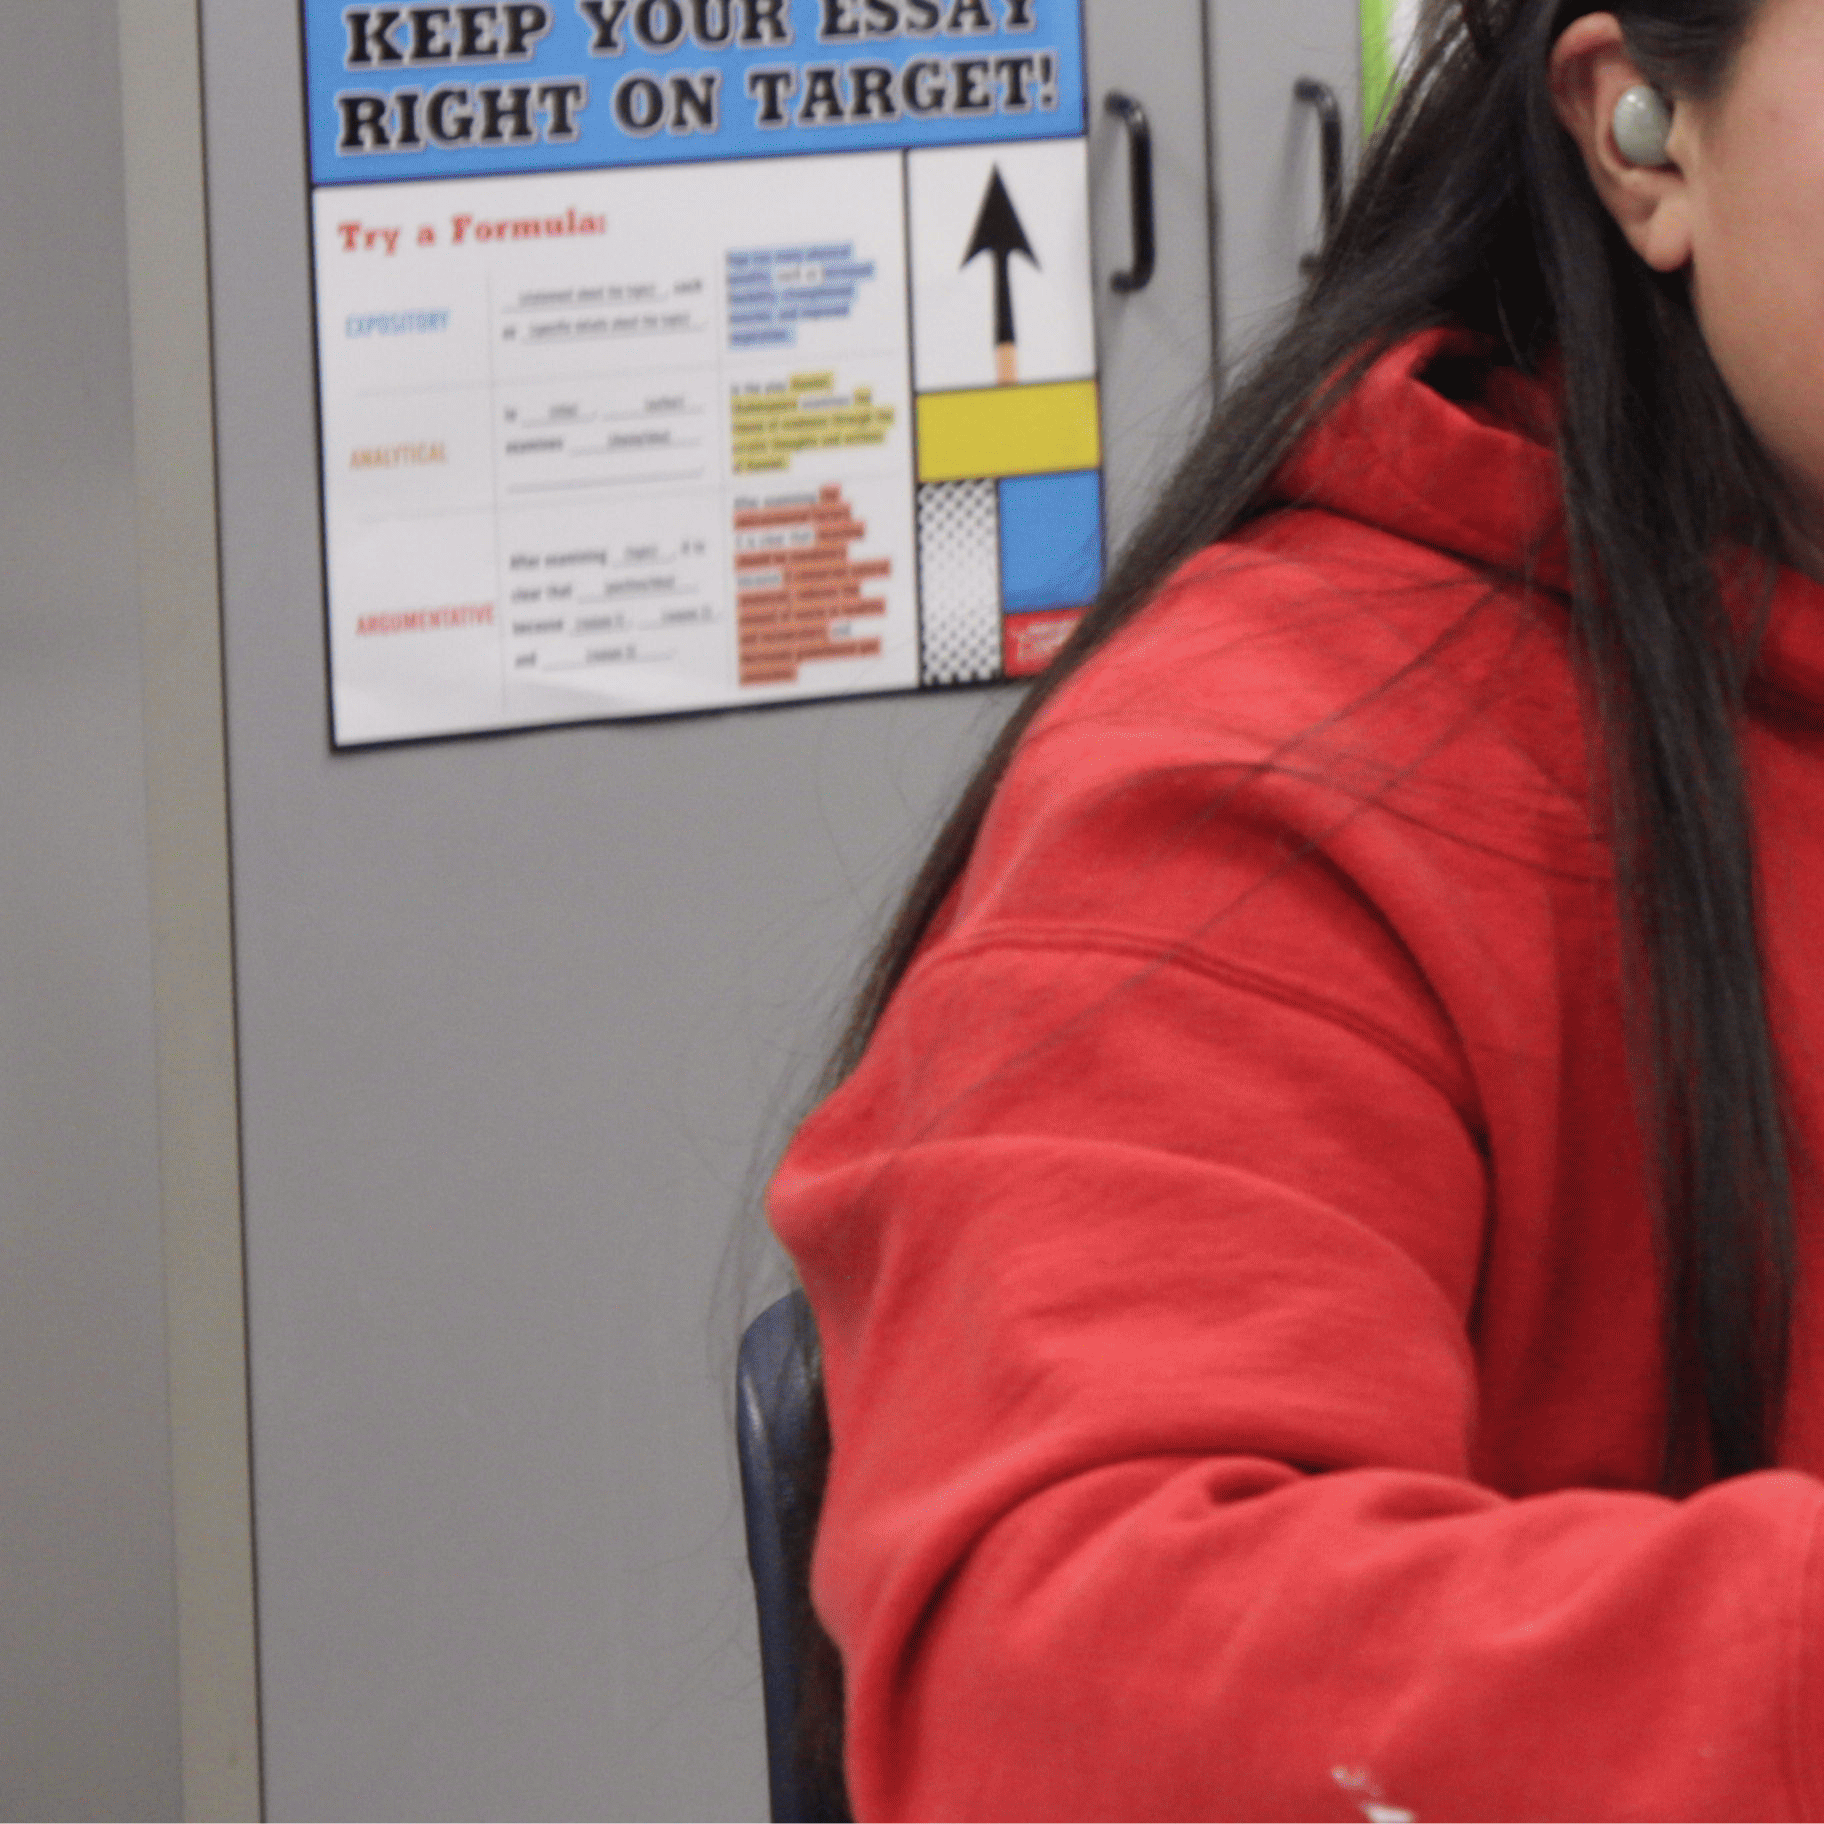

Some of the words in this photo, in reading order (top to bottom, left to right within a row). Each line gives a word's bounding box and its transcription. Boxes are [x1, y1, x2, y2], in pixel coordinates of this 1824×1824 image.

[341, 0, 551, 69] KEEP
[336, 80, 583, 154] RIGHT
[612, 72, 720, 136] ON
[748, 49, 1057, 129] TARGET!
[337, 220, 399, 256] Try
[417, 225, 436, 246] a
[451, 207, 606, 244] Formula:
[345, 308, 450, 339] EXPOSITORY
[349, 441, 447, 471] ANALYTICAL
[356, 602, 495, 636] ARGUMENTATIVE
